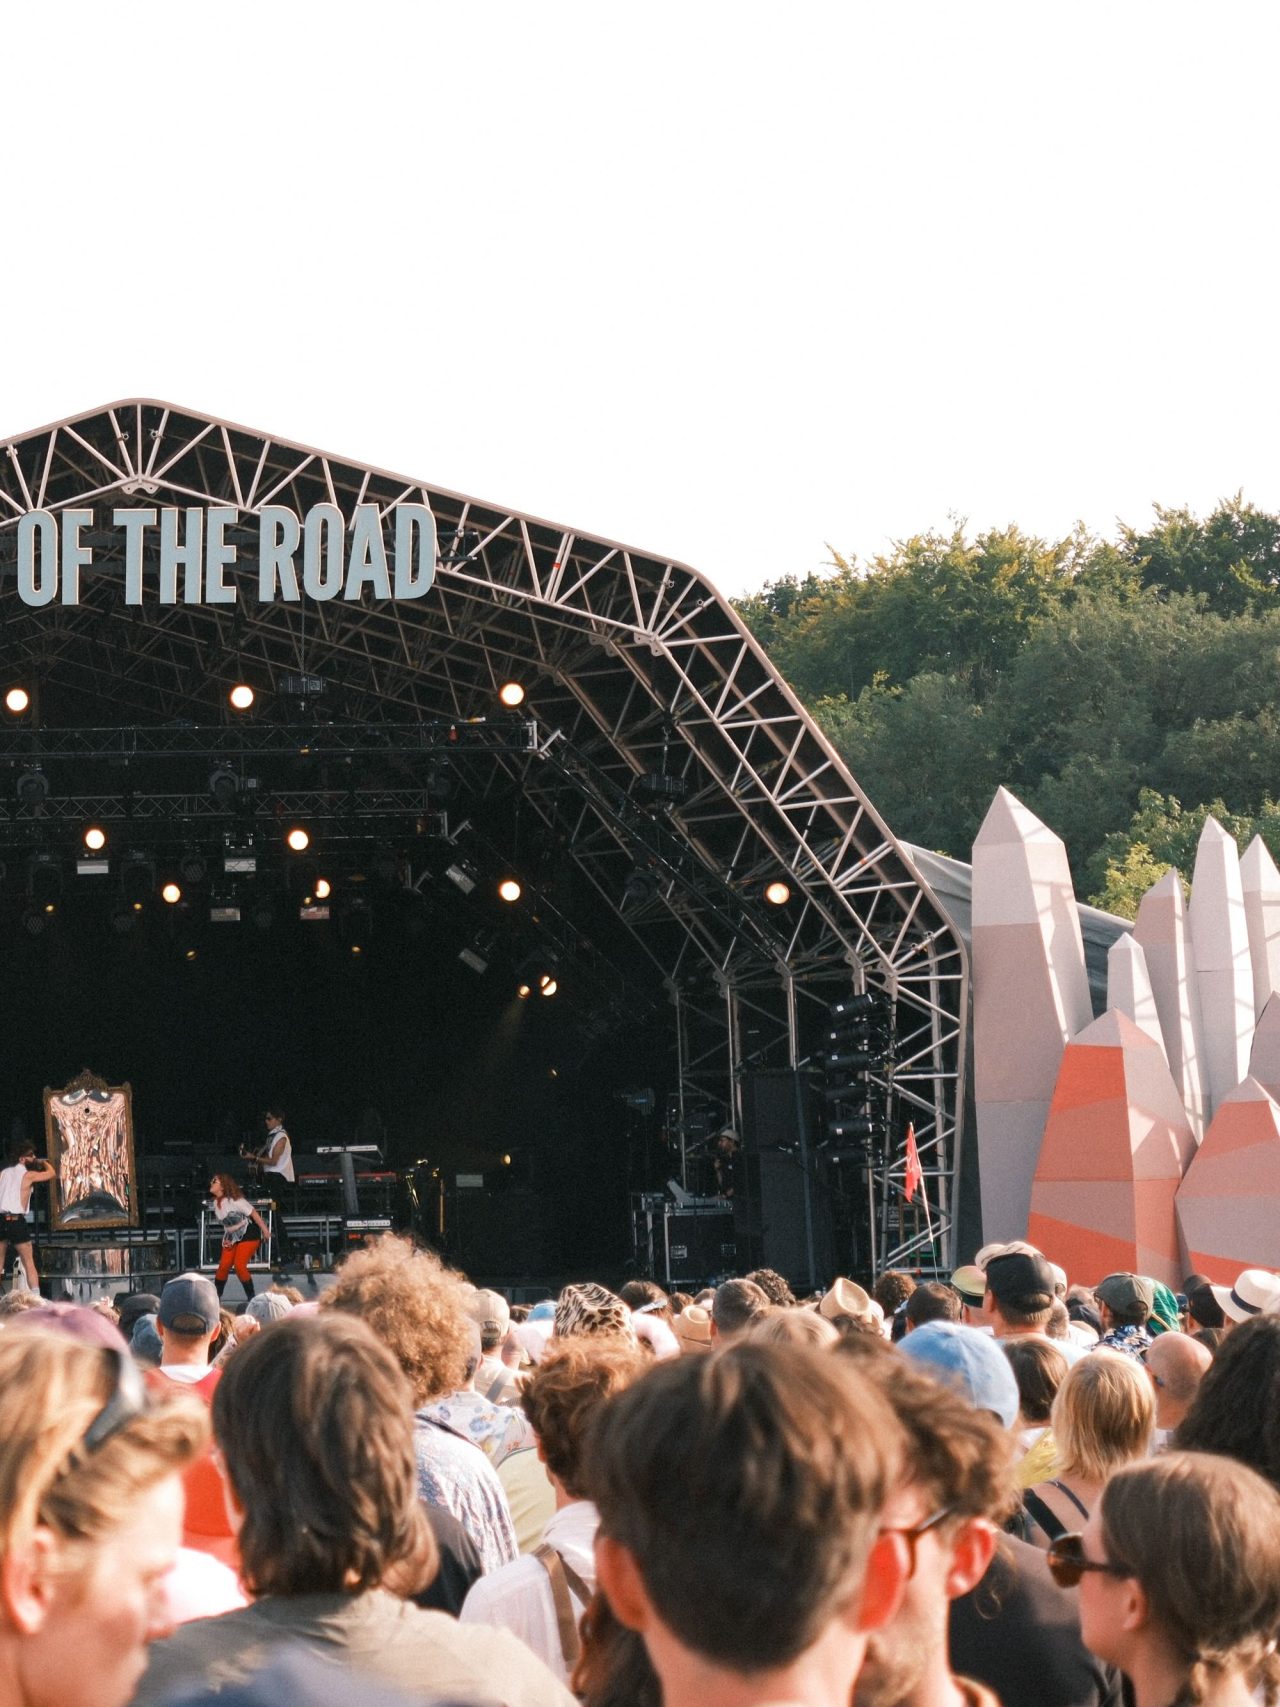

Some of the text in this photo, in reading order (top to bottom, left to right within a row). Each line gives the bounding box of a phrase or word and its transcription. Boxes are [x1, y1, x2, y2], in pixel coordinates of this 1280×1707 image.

[20, 508, 94, 607] OF
[113, 507, 239, 605] THE
[259, 503, 437, 602] ROAD
